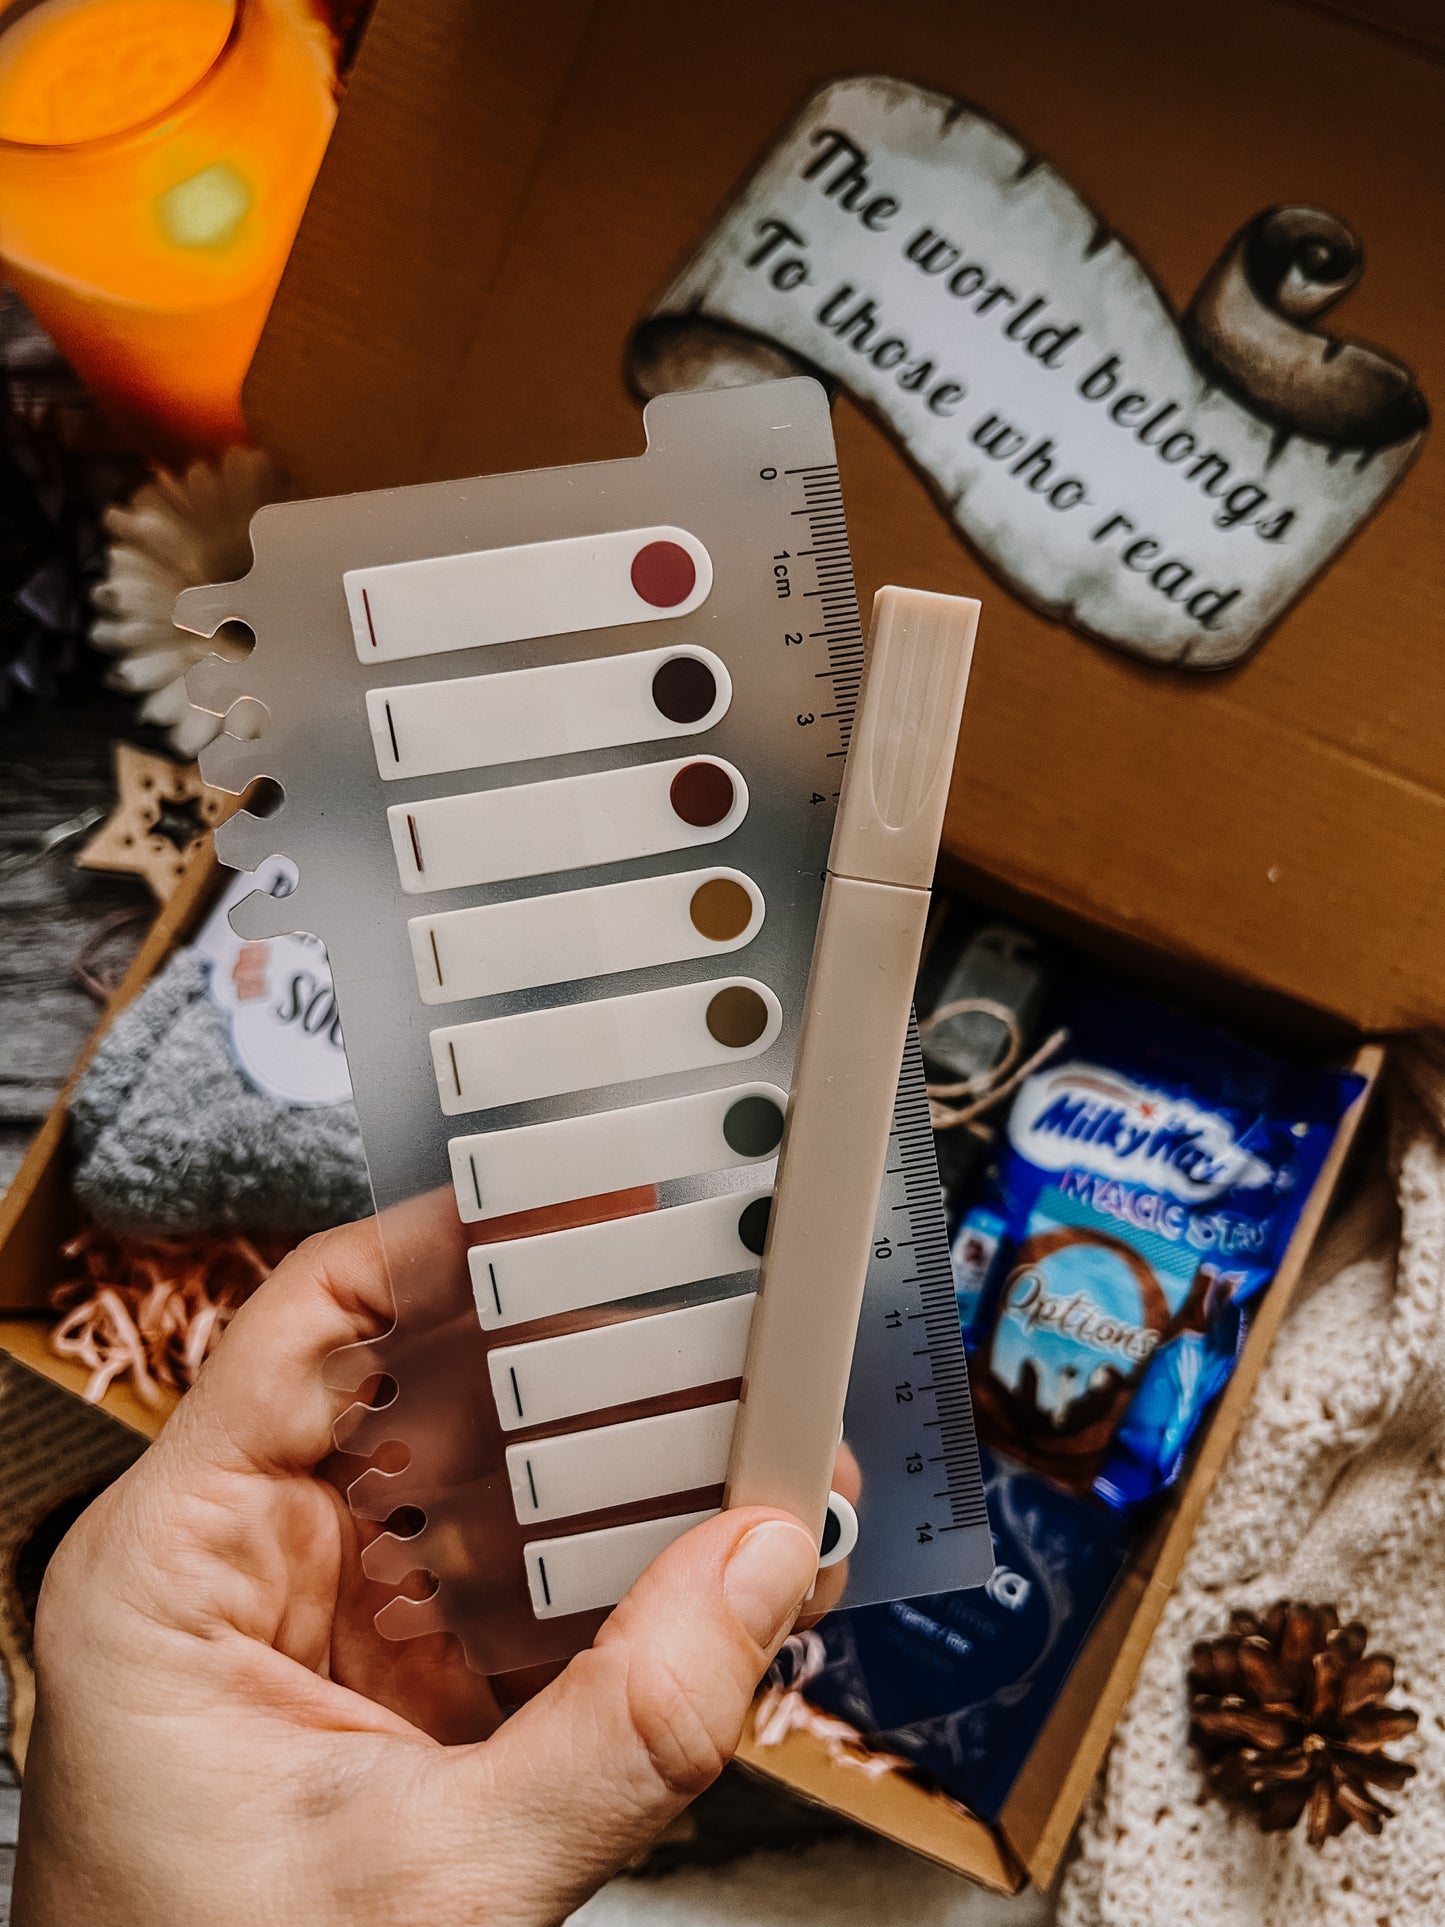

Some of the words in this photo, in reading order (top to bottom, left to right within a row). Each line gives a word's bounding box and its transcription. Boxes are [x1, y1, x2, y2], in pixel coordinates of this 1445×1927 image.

[801, 129, 899, 231] The
[905, 226, 1080, 370] world
[1077, 355, 1296, 545] belongs
[744, 218, 813, 292] To
[817, 283, 966, 417] those
[969, 410, 1094, 512] who
[1093, 509, 1242, 631] read
[759, 467, 777, 481] 0
[784, 632, 803, 647] 2
[796, 713, 815, 727] 3
[809, 792, 827, 805] 4
[873, 1236, 892, 1259] 10
[884, 1310, 903, 1329] 11
[1001, 1264, 1160, 1360] Options
[895, 1381, 913, 1404] 12
[905, 1452, 923, 1475] 13
[916, 1522, 934, 1544] 14
